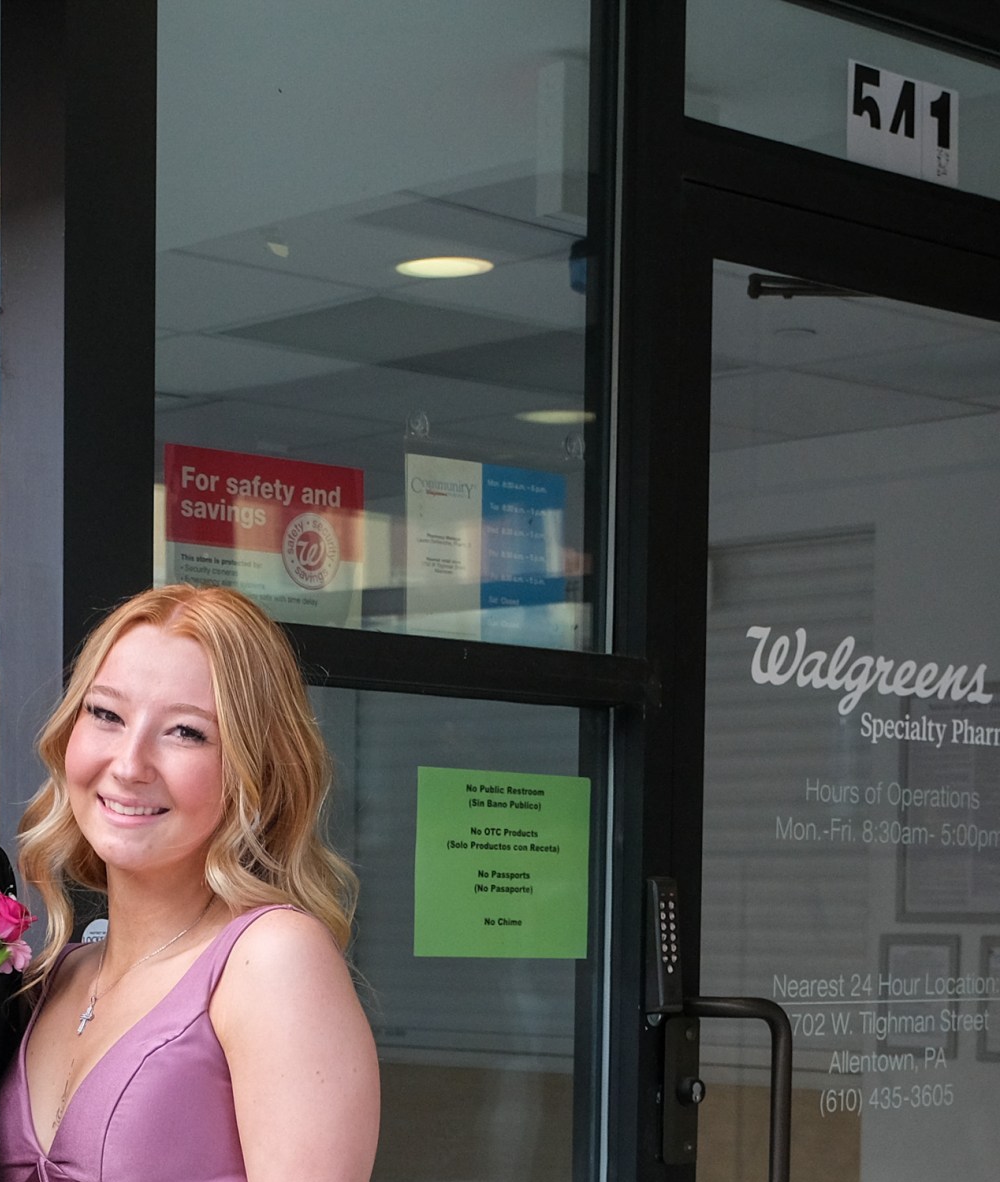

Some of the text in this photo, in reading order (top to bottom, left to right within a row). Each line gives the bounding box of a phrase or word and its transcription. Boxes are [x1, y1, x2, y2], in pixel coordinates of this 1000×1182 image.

[181, 465, 341, 508] For safety and
[181, 499, 267, 529] savings
[288, 521, 304, 555] safety
[295, 566, 328, 584] savings
[746, 625, 993, 715] Walgreens
[860, 712, 947, 748] Specialty
[466, 784, 545, 796] No Public Restroom
[805, 778, 980, 811] Hours of Operations
[469, 799, 485, 808] (Sin
[510, 801, 542, 811] Publico)
[470, 827, 538, 838] No OTC Products
[447, 840, 560, 854] (Solo Productos con Receta)
[478, 870, 531, 880] No Passports
[474, 884, 533, 894] (No Pasaporte)
[484, 918, 495, 926] No
[773, 972, 999, 998] Nearest 24 Hour Location:
[831, 1012, 853, 1036] W.
[859, 1010, 935, 1040] Tilghman
[940, 1009, 989, 1032] Street
[829, 1047, 947, 1075] Allentown, PA
[820, 1084, 954, 1117] (610) 435-3605
